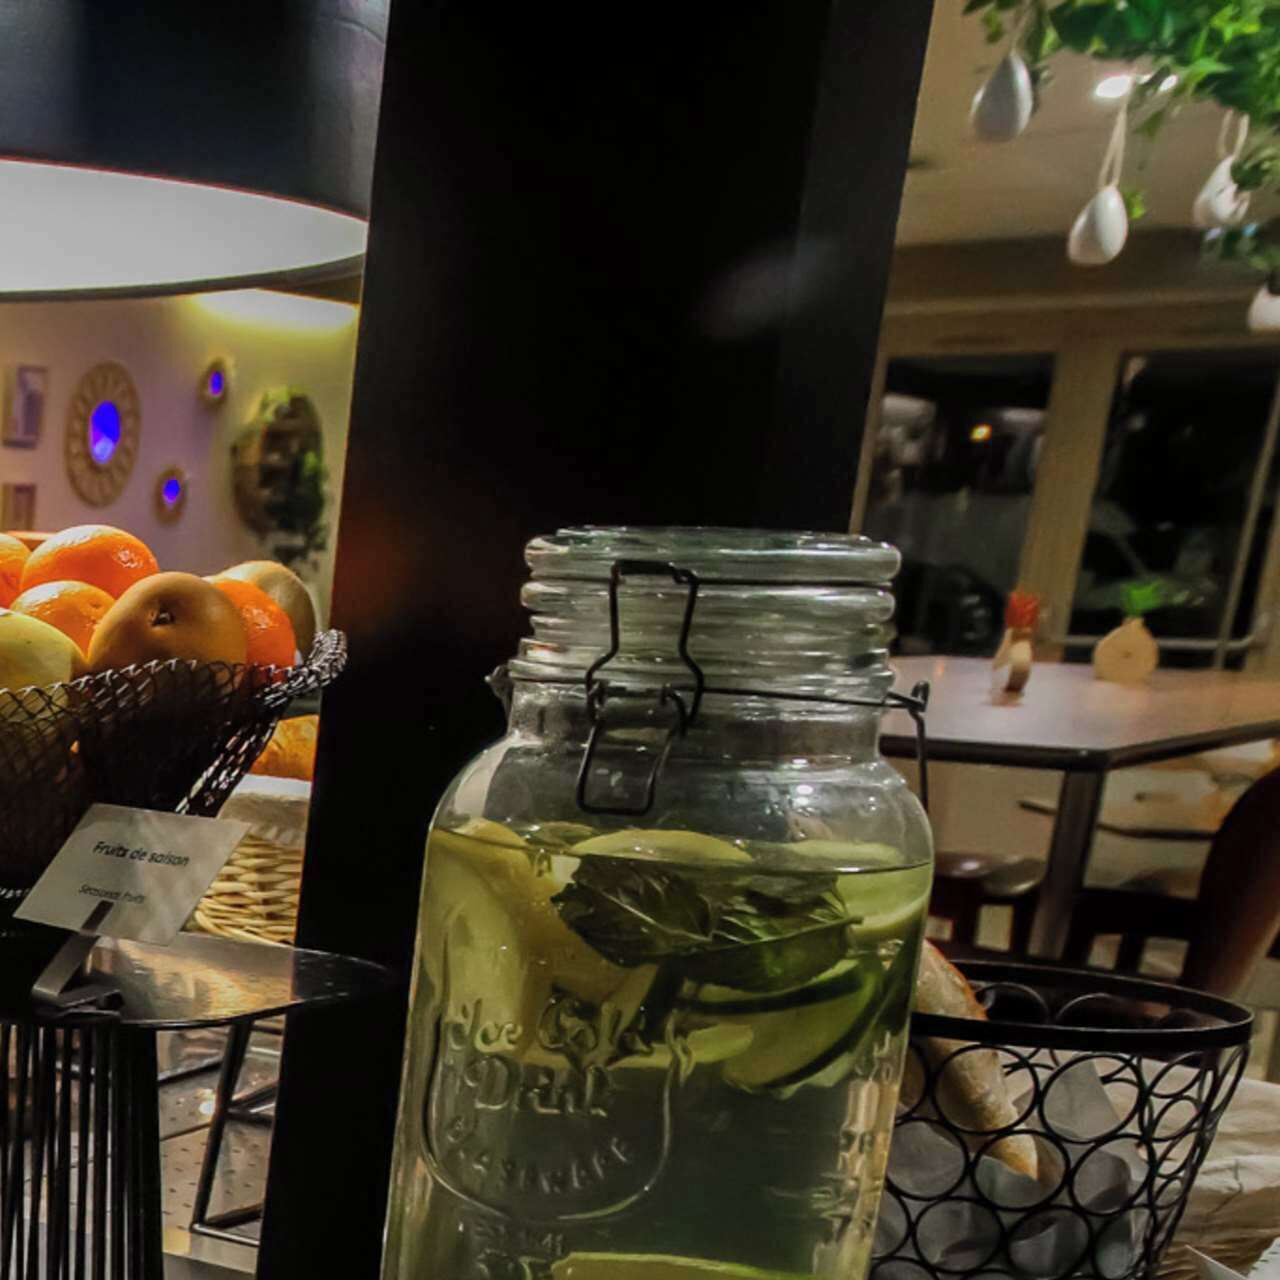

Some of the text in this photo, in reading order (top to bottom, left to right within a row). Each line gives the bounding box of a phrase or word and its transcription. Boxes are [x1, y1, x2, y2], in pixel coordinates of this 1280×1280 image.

[92, 841, 190, 867] Fruits de saison
